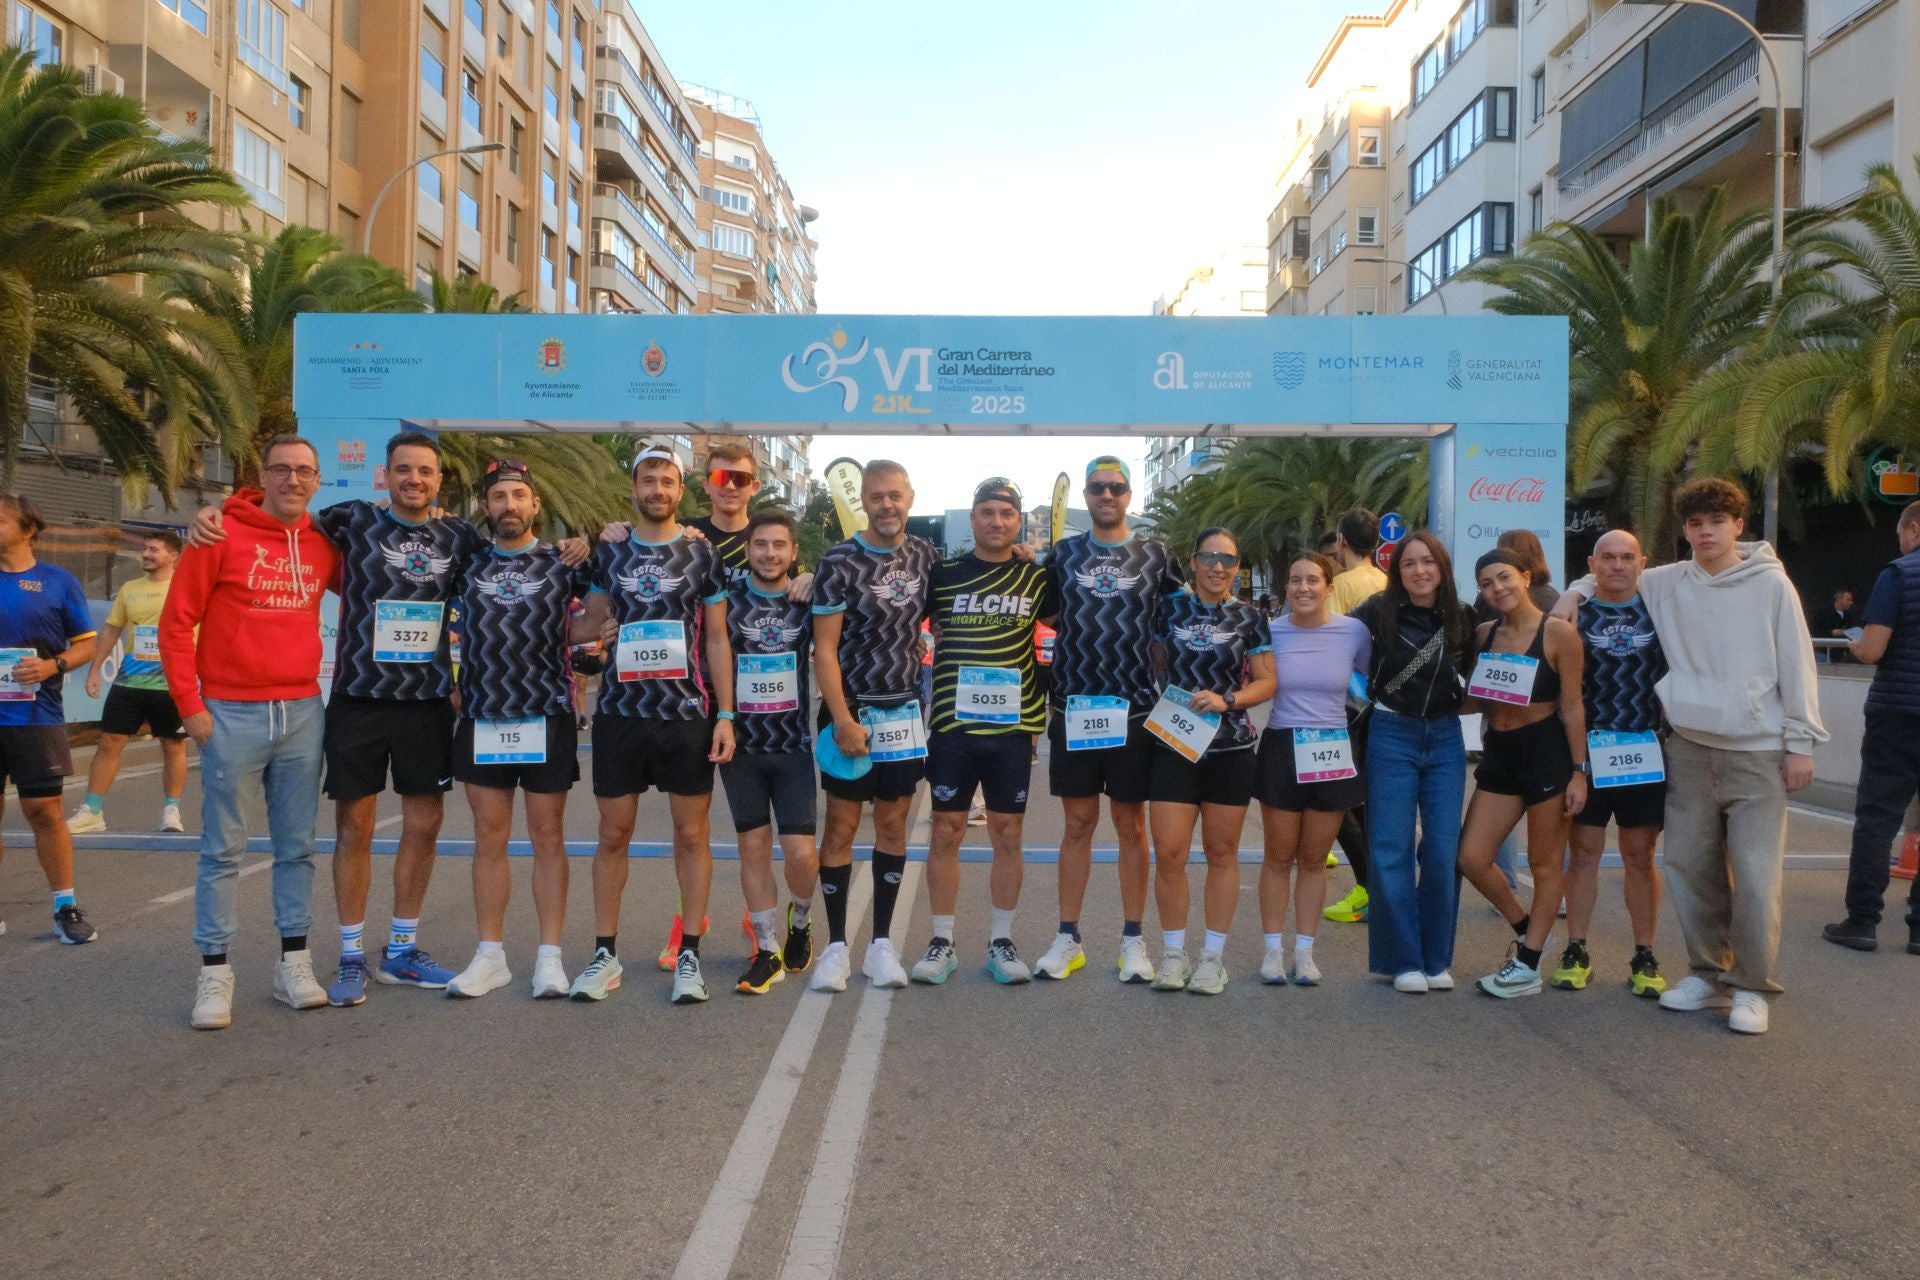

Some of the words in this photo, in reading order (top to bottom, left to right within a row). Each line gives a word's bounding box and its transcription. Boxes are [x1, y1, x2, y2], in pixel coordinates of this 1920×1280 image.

[937, 347, 974, 362] Gran
[977, 347, 1032, 362] Carrera
[308, 357, 361, 365] AYUNTAMIENTO
[370, 357, 423, 366] AJUNTAMENT
[1319, 356, 1424, 369] MONTEMAR
[1466, 359, 1543, 370] GENERALITAT
[341, 366, 367, 374] SANTA
[369, 366, 389, 374] POLA
[873, 347, 933, 392] VI
[937, 362, 960, 376] del
[963, 362, 1055, 376] Mediterráneo
[1193, 369, 1252, 380] DIPUTACIÓN
[1467, 371, 1541, 382] VALENCIANA
[524, 381, 580, 392] Ayuntamiento
[1193, 381, 1204, 390] DE
[1207, 381, 1252, 390] ALICANTE
[530, 391, 542, 400] de
[543, 390, 574, 400] Alicante
[970, 396, 1025, 415] 2025
[1483, 446, 1557, 459] vectalia
[1484, 527, 1499, 538] HLA
[1379, 552, 1393, 561] ST
[632, 564, 668, 578] ESTESO
[952, 594, 1032, 617] ELCHE
[754, 616, 788, 629] ESTESO
[393, 630, 429, 642] 3372
[632, 648, 669, 662] 1036
[1484, 668, 1518, 684] 2850
[751, 681, 784, 694] 3856
[971, 693, 1007, 705] 5035
[1083, 717, 1109, 730] 2181
[1170, 713, 1195, 735] 962
[499, 732, 521, 744] 115
[878, 729, 909, 743] 3587
[1311, 749, 1341, 762] 1474
[1608, 753, 1643, 767] 2186
